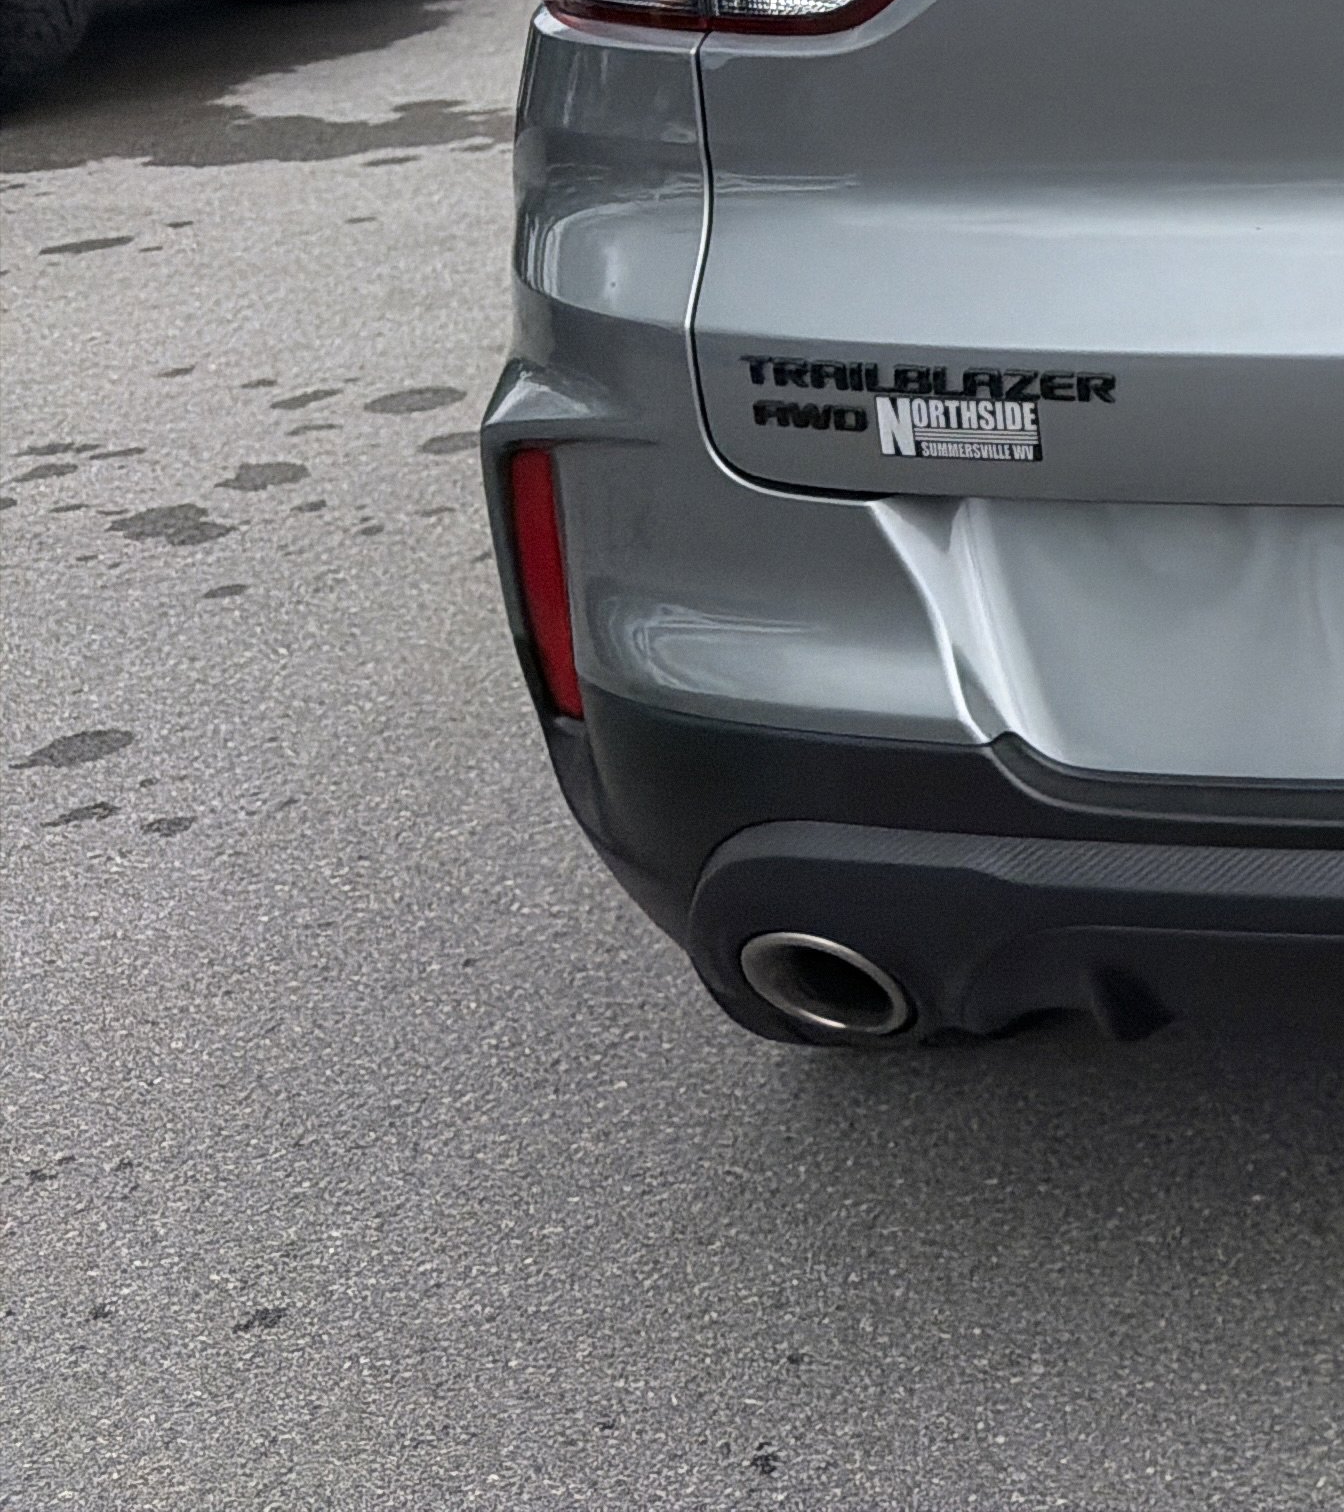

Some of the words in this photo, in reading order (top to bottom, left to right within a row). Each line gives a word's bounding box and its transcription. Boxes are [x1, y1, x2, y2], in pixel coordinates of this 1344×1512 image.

[739, 355, 1117, 404] TRAILBLAZER
[752, 399, 868, 432] AWD
[876, 396, 1038, 456] NORTHSIDE
[921, 441, 1011, 459] SUMMERSVILLE
[1013, 445, 1034, 460] WV
